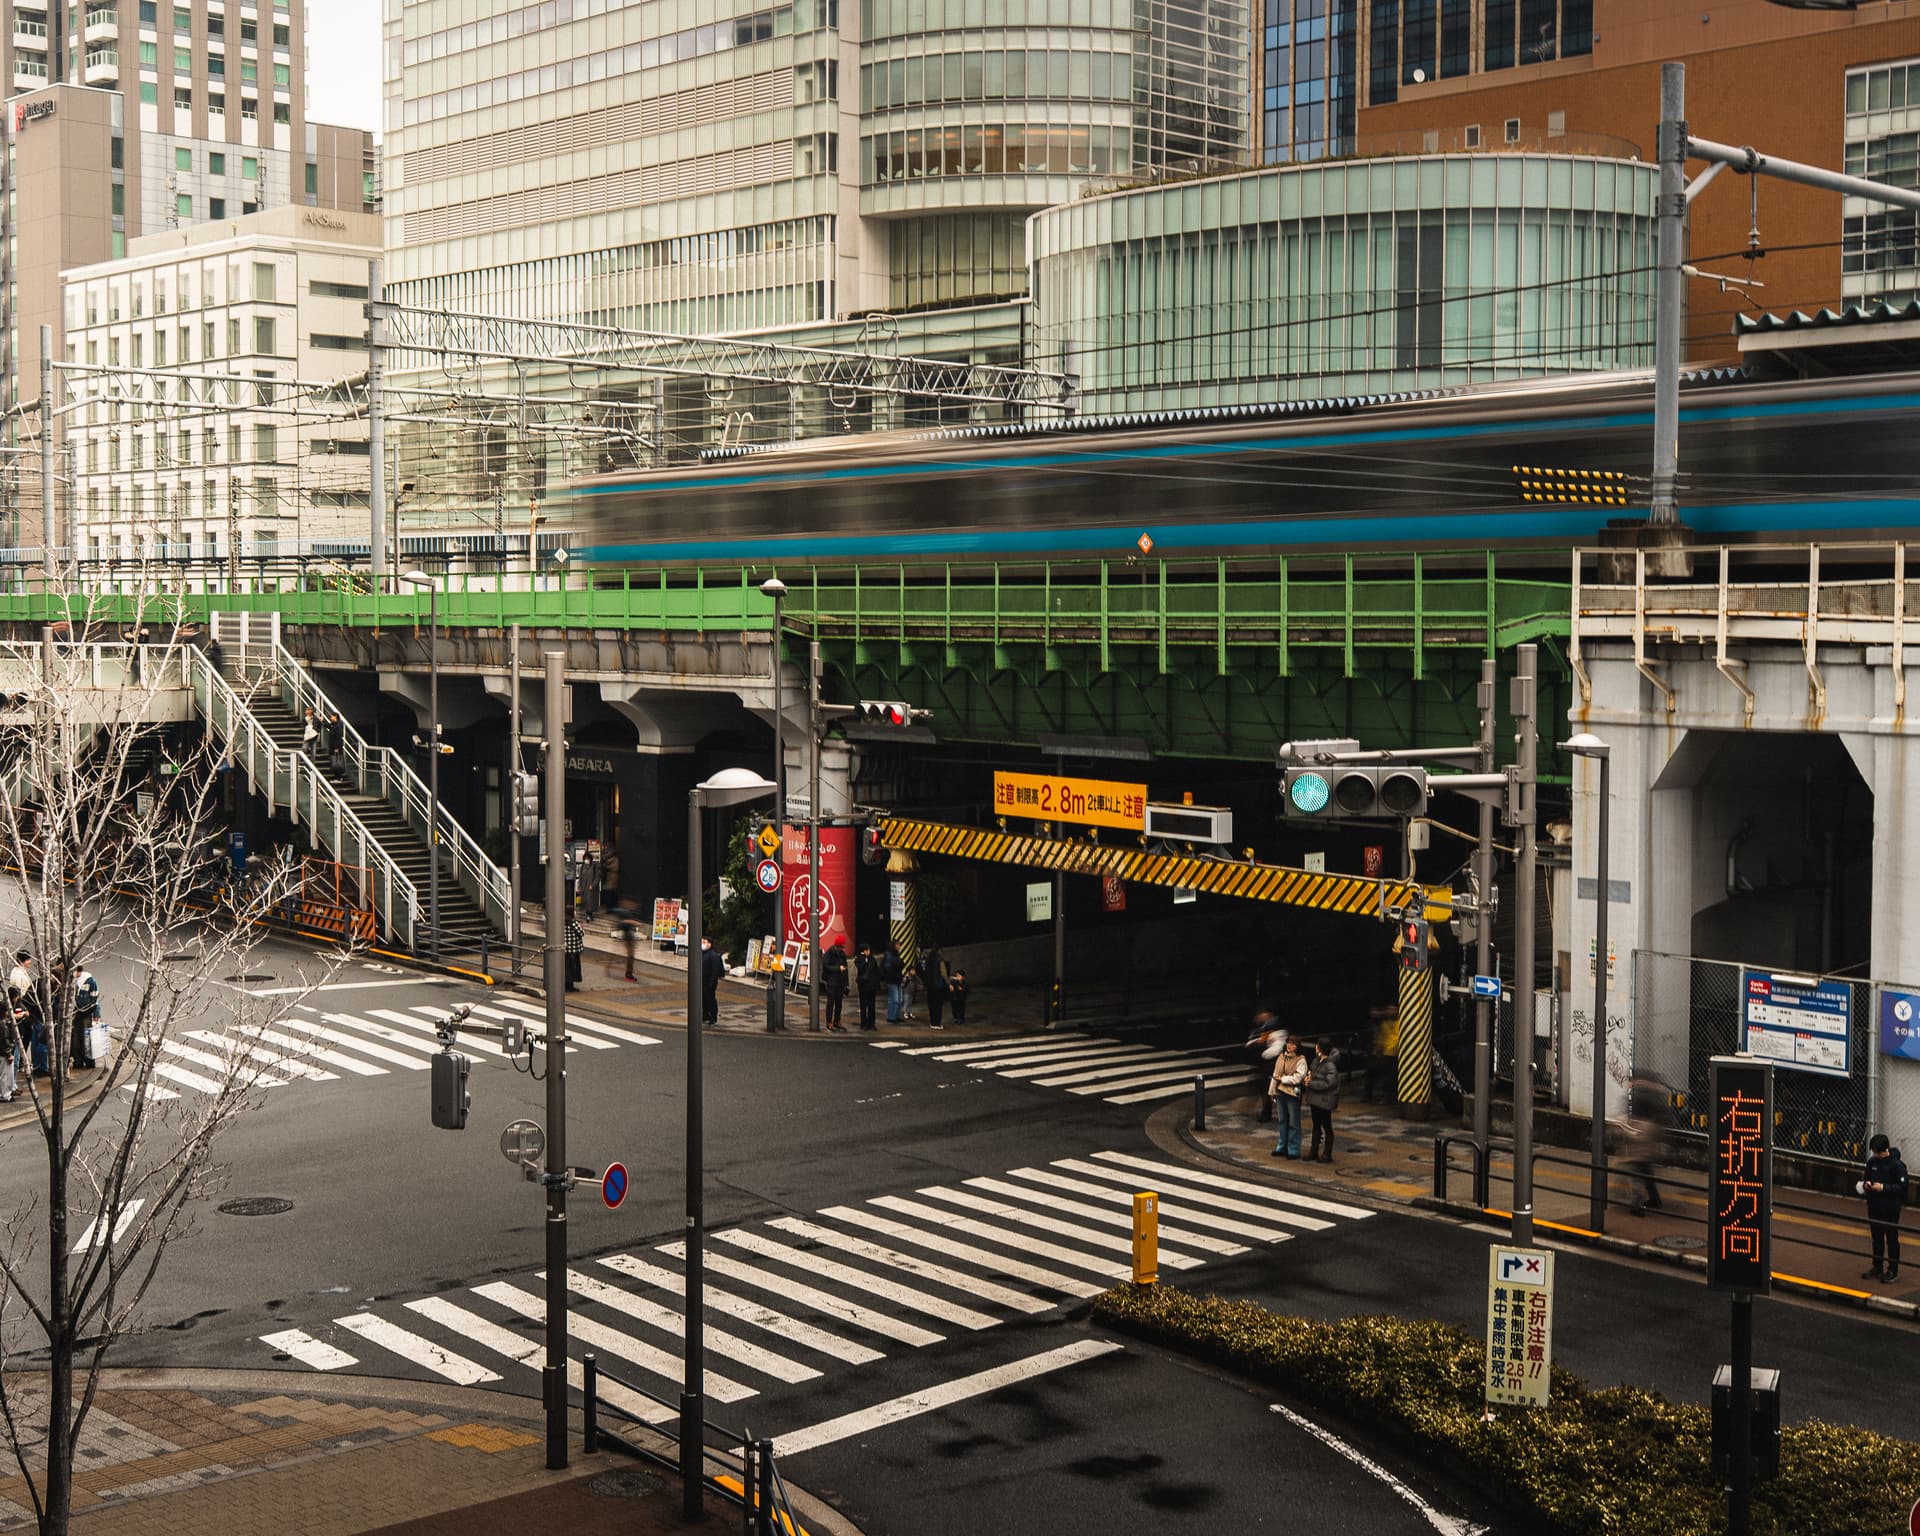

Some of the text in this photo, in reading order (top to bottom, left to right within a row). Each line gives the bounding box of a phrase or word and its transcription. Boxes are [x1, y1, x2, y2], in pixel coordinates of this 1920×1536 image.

[996, 782, 1144, 819] 注意 制限高 2.8m 2t車以上 注意
[1720, 1089, 1765, 1263] 右折方向
